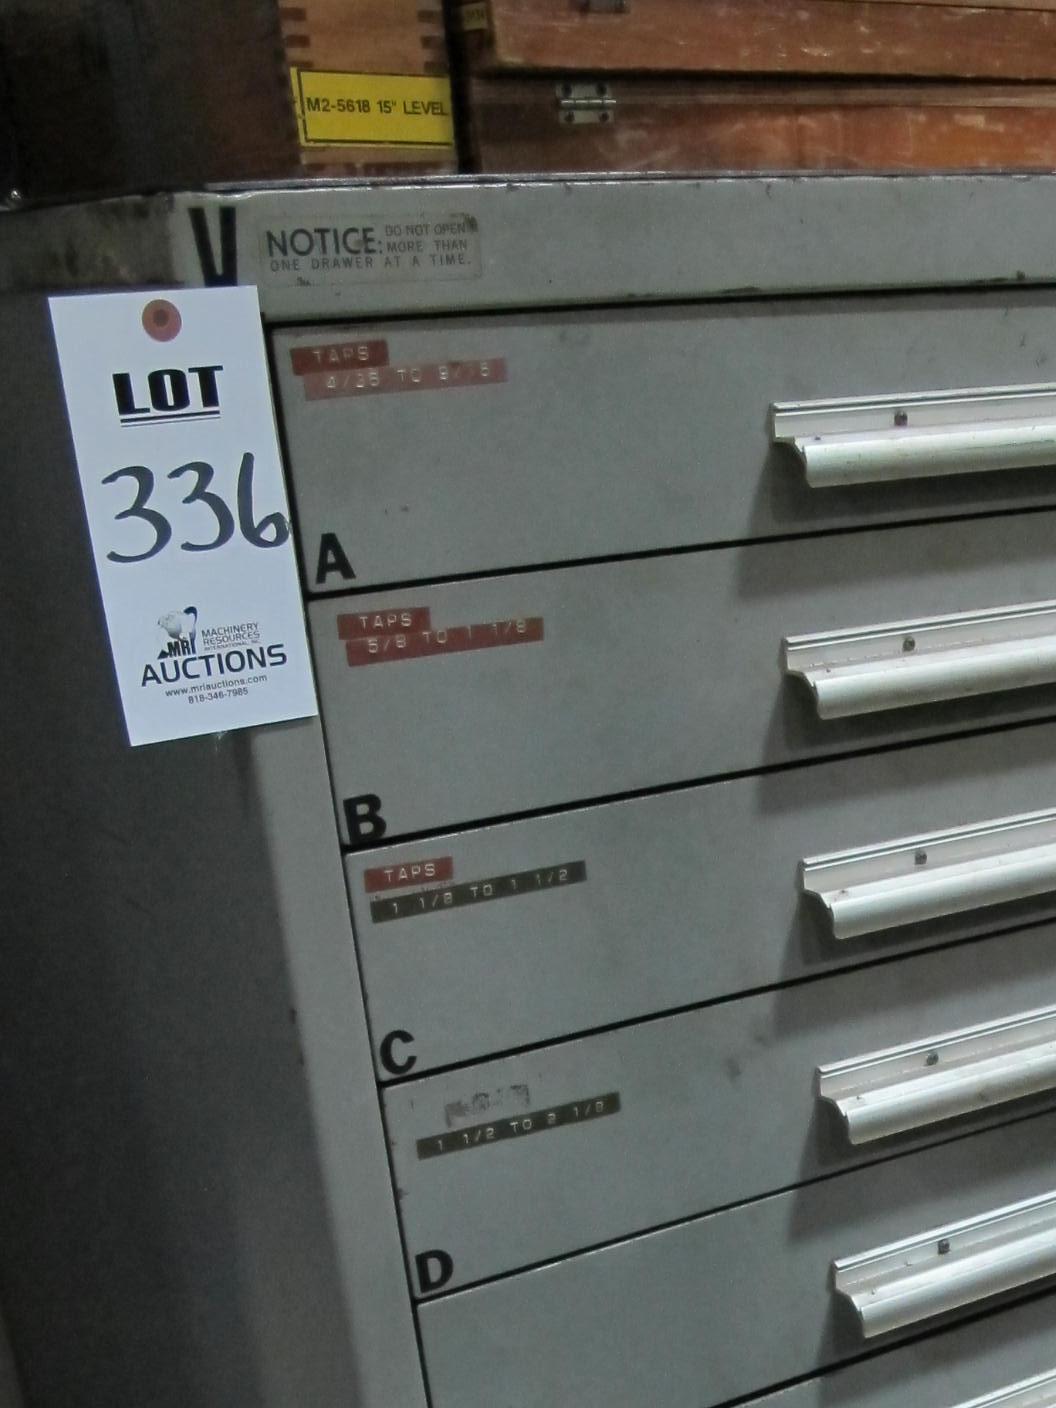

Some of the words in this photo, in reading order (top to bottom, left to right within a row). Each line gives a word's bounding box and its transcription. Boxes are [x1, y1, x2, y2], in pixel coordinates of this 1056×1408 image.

[306, 97, 370, 113] M2-5618
[377, 100, 397, 113] 15"
[403, 100, 448, 115] LEVEL
[266, 227, 383, 256] NOTICE:
[385, 225, 402, 236] DO
[406, 224, 430, 236] NOT
[434, 223, 466, 235] OPEN
[386, 241, 423, 252] MORE
[435, 240, 467, 250] THAN
[270, 259, 300, 272] ONE
[311, 257, 373, 270] DRAWER
[384, 256, 401, 268] AT
[412, 256, 420, 267] A
[431, 254, 471, 266] TIME.
[313, 345, 370, 364] TAPS
[397, 367, 422, 383] TO
[112, 365, 224, 416] LOT
[101, 452, 290, 564] 336
[316, 532, 357, 585] A
[201, 621, 260, 638] MACHINERY
[359, 612, 412, 629] TAPS
[166, 630, 197, 659] MRI
[202, 631, 261, 647] RESOURCES
[367, 634, 407, 654] 5/8
[422, 630, 448, 645] TO
[141, 643, 288, 687] AUCTIONS
[165, 674, 268, 697] www.mriauctions.com
[188, 687, 249, 704] 818-346-7985
[343, 794, 387, 841] B
[384, 862, 436, 883] TAPS
[392, 901, 398, 915] 1
[419, 892, 454, 909] 1/8
[470, 883, 494, 898] TO
[536, 868, 568, 886] 1/2
[379, 1030, 417, 1075] C
[463, 1128, 496, 1145] 1/2
[509, 1119, 533, 1134] TO
[415, 1249, 454, 1294] D
